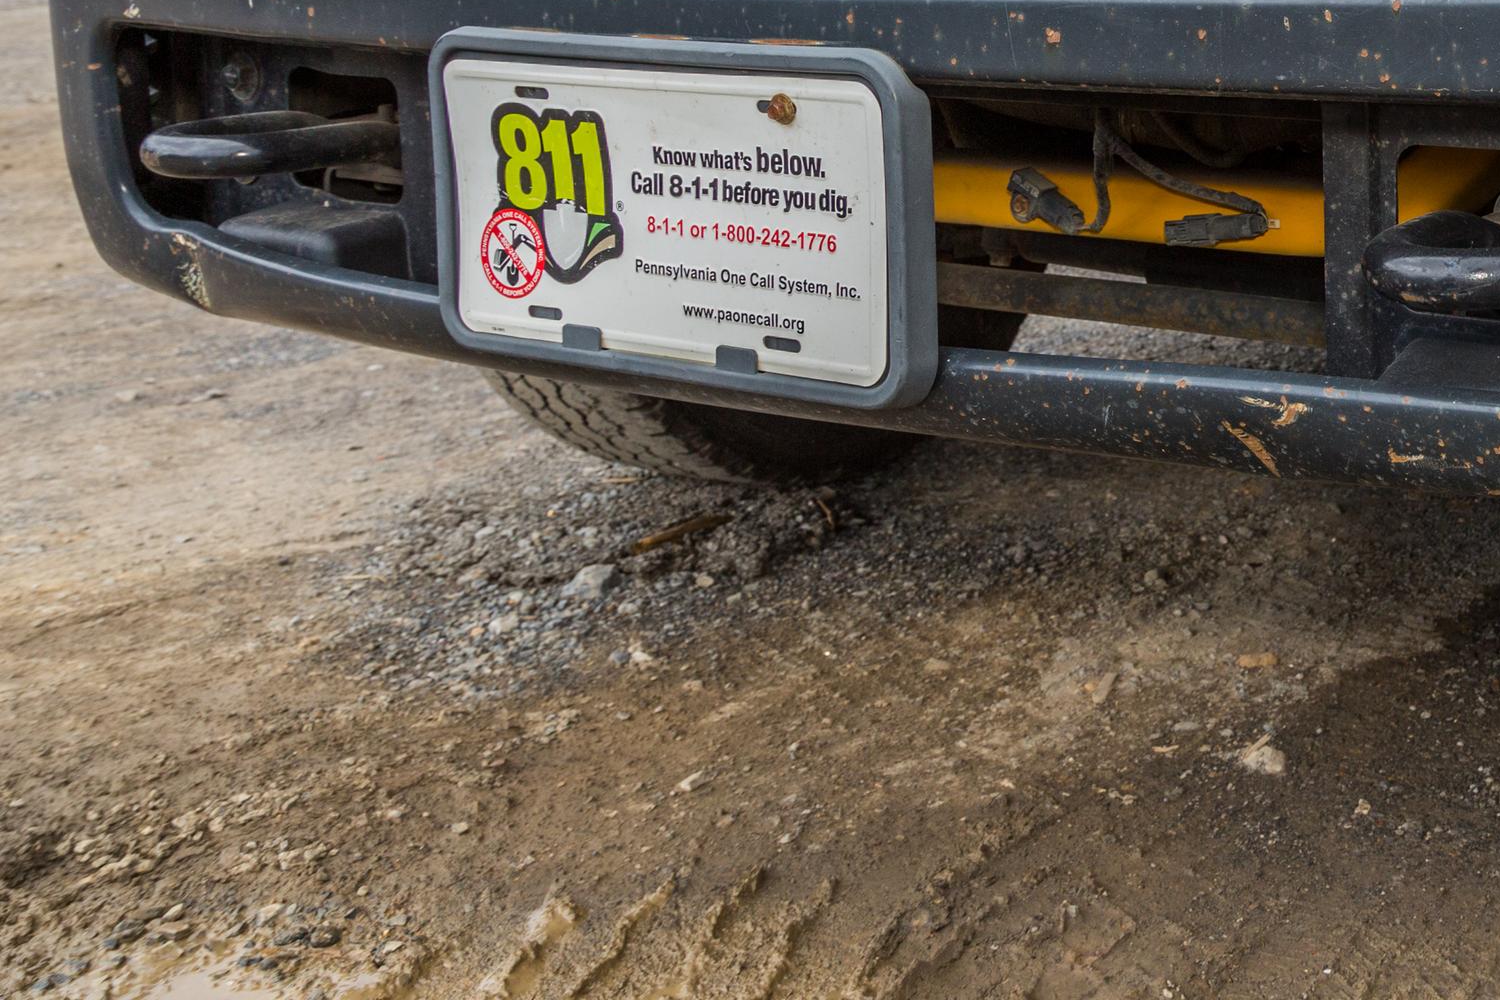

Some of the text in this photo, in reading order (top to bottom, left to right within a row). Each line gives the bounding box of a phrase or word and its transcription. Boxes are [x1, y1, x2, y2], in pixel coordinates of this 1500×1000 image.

[499, 114, 605, 216] 811
[653, 146, 825, 178] Know what's below.
[632, 172, 852, 218] Call 8-1-1 before you dig.
[513, 212, 527, 223] CALL
[648, 216, 836, 253] 8-1-1 or 1-800-242-1776
[483, 263, 493, 281] CALL
[503, 288, 524, 296] BEFORE
[523, 283, 534, 293] YOU
[636, 259, 860, 299] Pennsylvania One Call System, Inc.
[683, 305, 804, 334] www.paonecall.org
